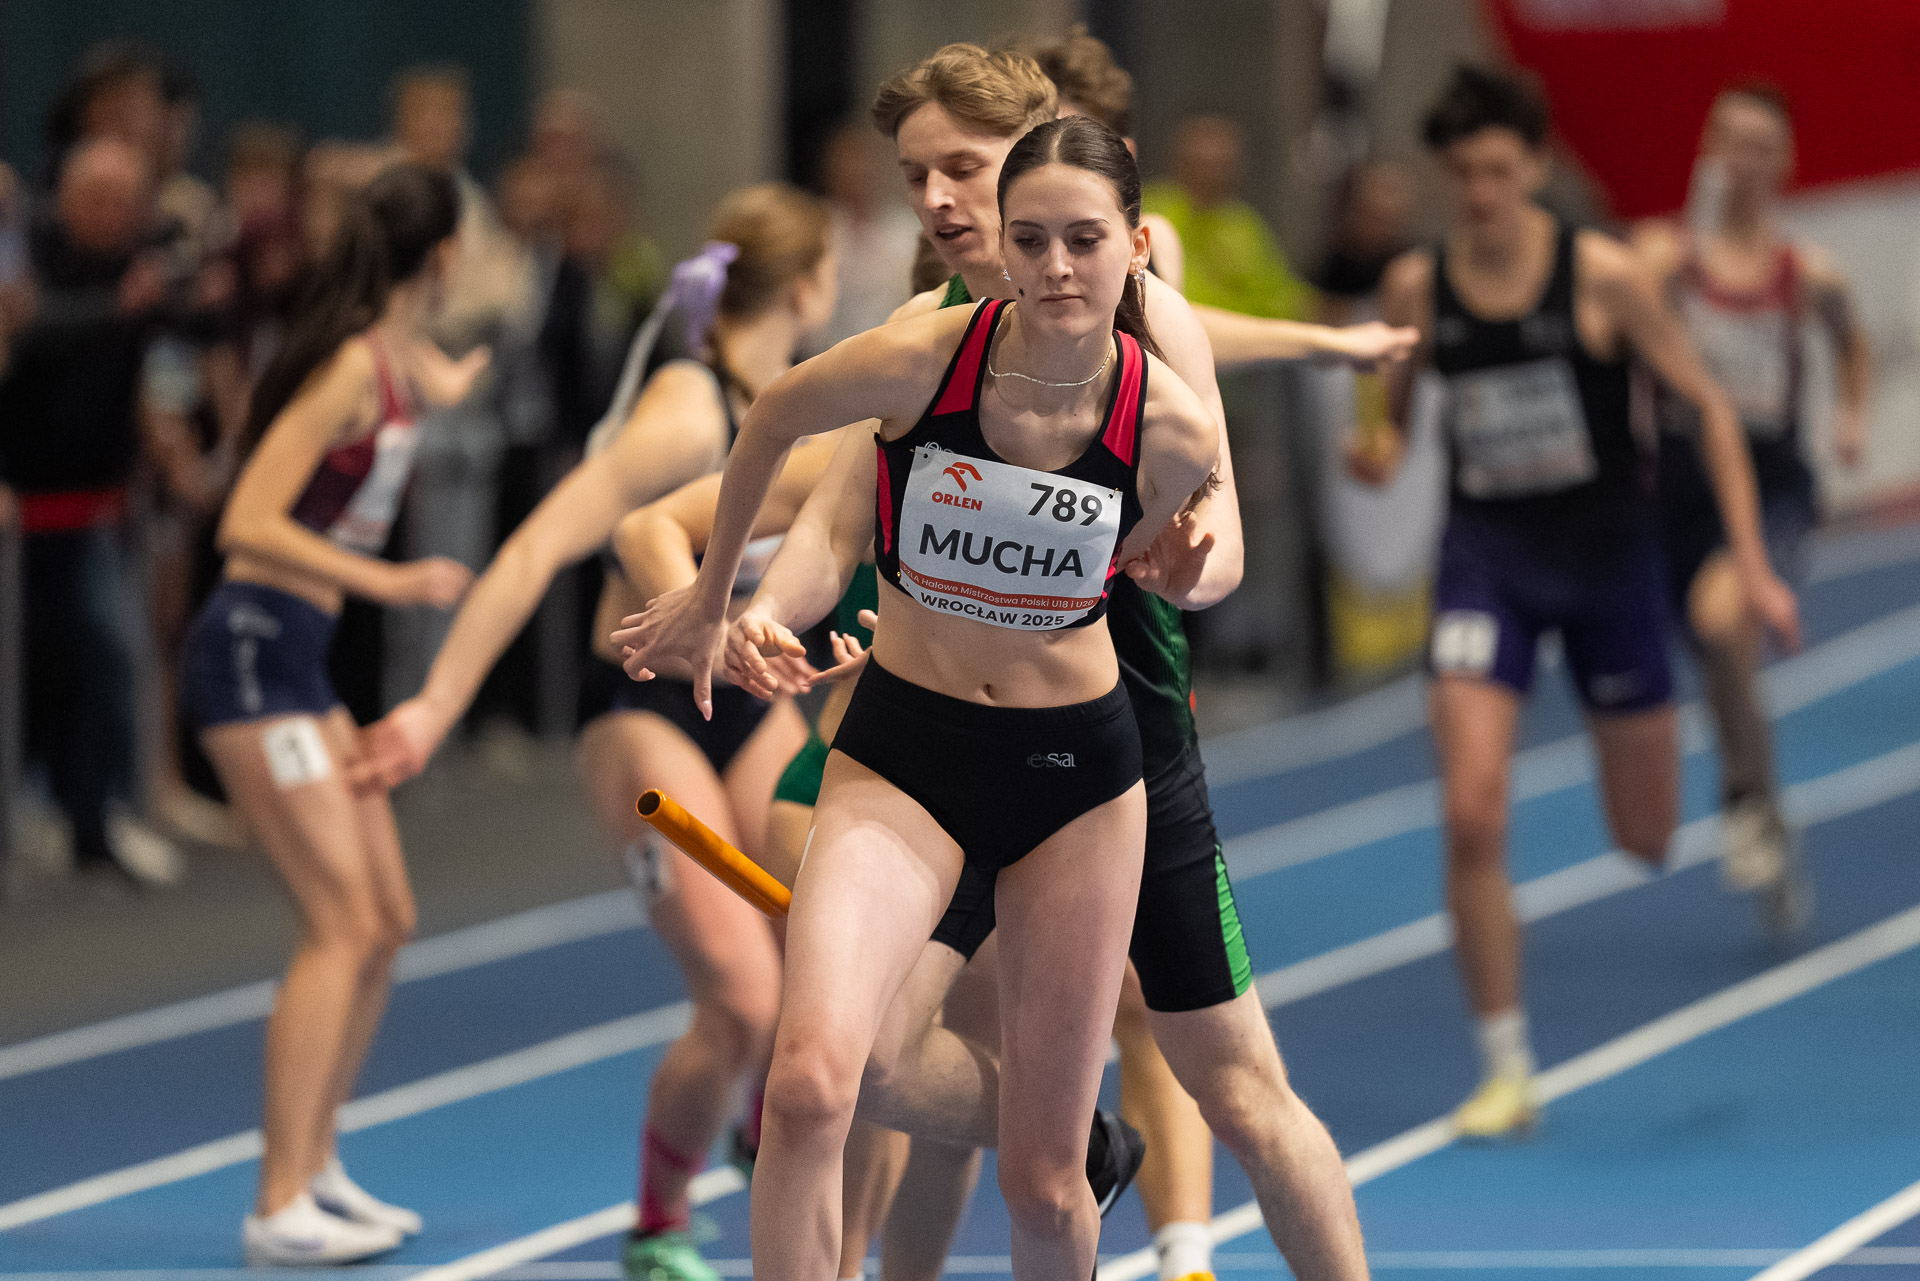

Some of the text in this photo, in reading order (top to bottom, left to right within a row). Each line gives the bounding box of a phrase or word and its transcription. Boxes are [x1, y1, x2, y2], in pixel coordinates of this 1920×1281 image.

[931, 491, 983, 512] ORLEN
[1028, 482, 1103, 526] 789
[919, 523, 1084, 578] MUCHA
[920, 592, 1065, 626] WROCŁAW 2025
[921, 577, 959, 592] Halowe
[960, 586, 1018, 605] Mistrzostwa
[1020, 597, 1050, 607] Polski
[1075, 599, 1094, 608] U20
